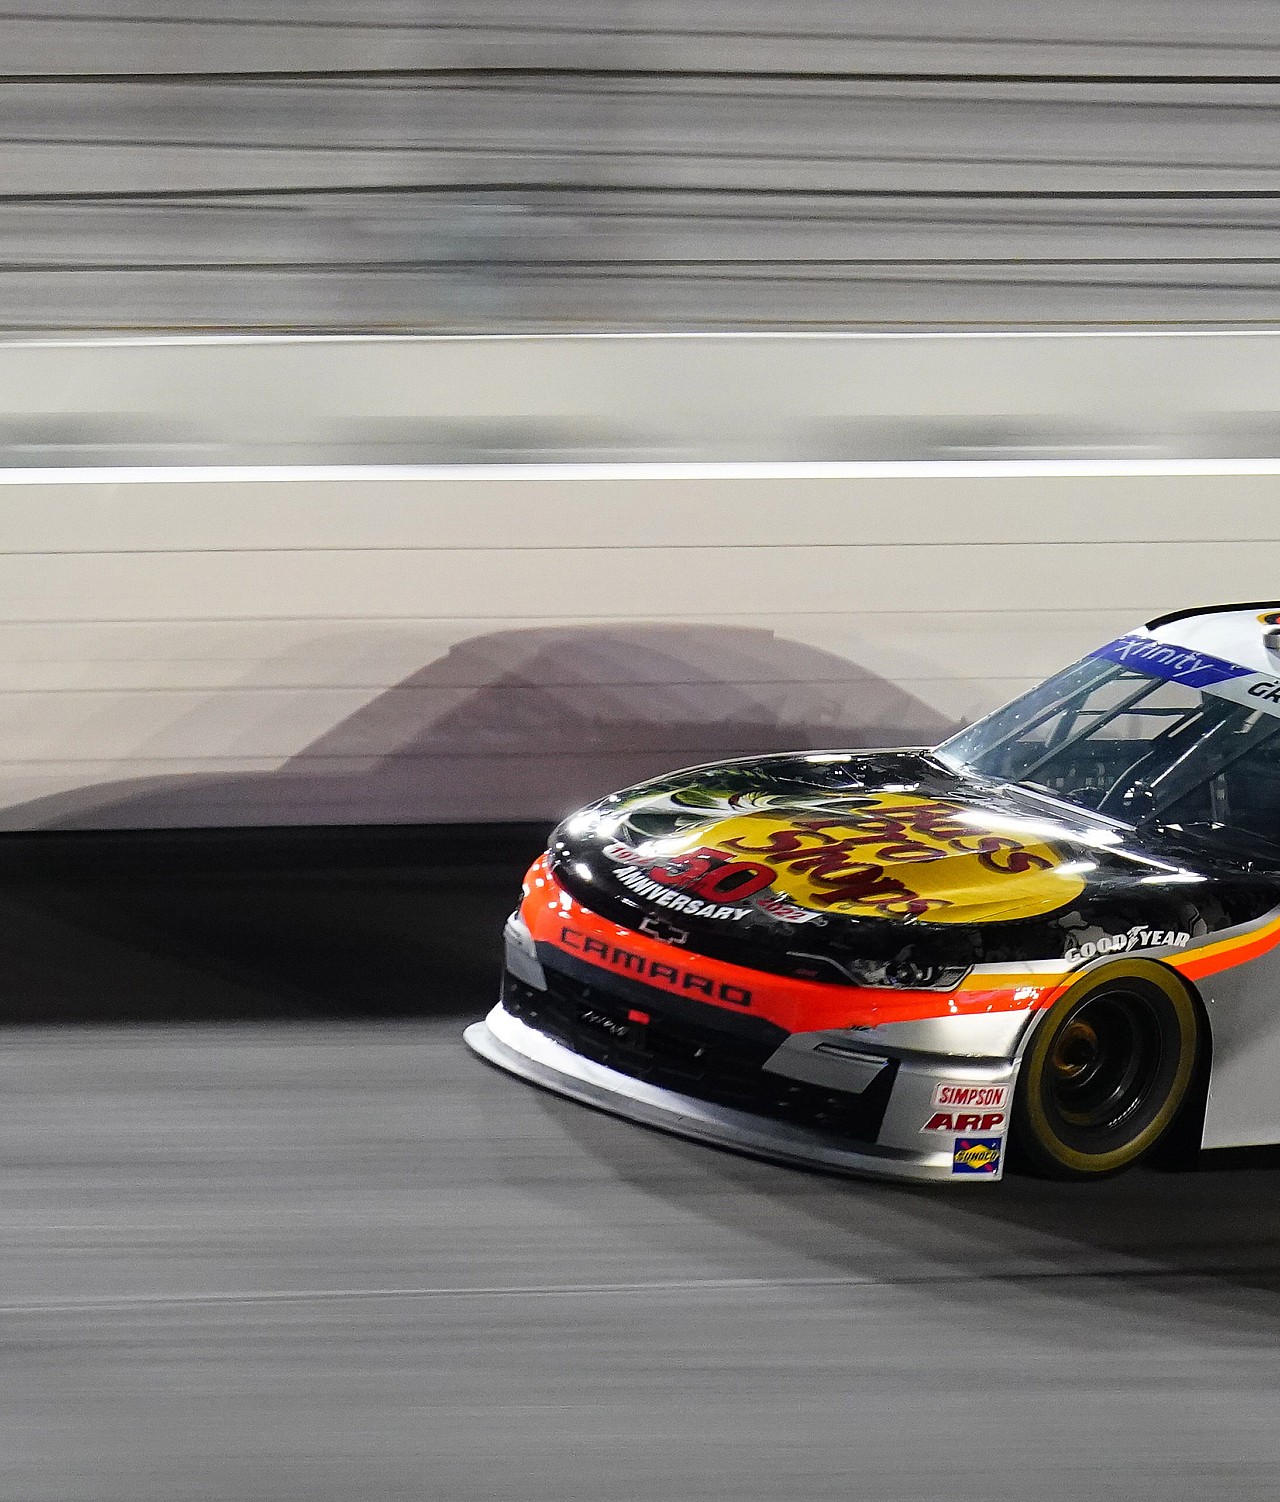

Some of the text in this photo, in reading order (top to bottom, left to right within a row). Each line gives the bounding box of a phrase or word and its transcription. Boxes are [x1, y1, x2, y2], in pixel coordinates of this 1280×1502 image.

[1114, 639, 1214, 678] xfinity
[790, 815, 948, 862] Pro
[855, 802, 1055, 875] Bass
[611, 865, 754, 921] ANNIVERSARY
[648, 846, 778, 903] 50
[717, 829, 955, 919] Shops
[560, 927, 753, 1007] CAMARO
[924, 1113, 1004, 1131] ARP
[939, 1087, 1004, 1106] SIMPSON
[955, 1150, 999, 1162] SUNOCO
